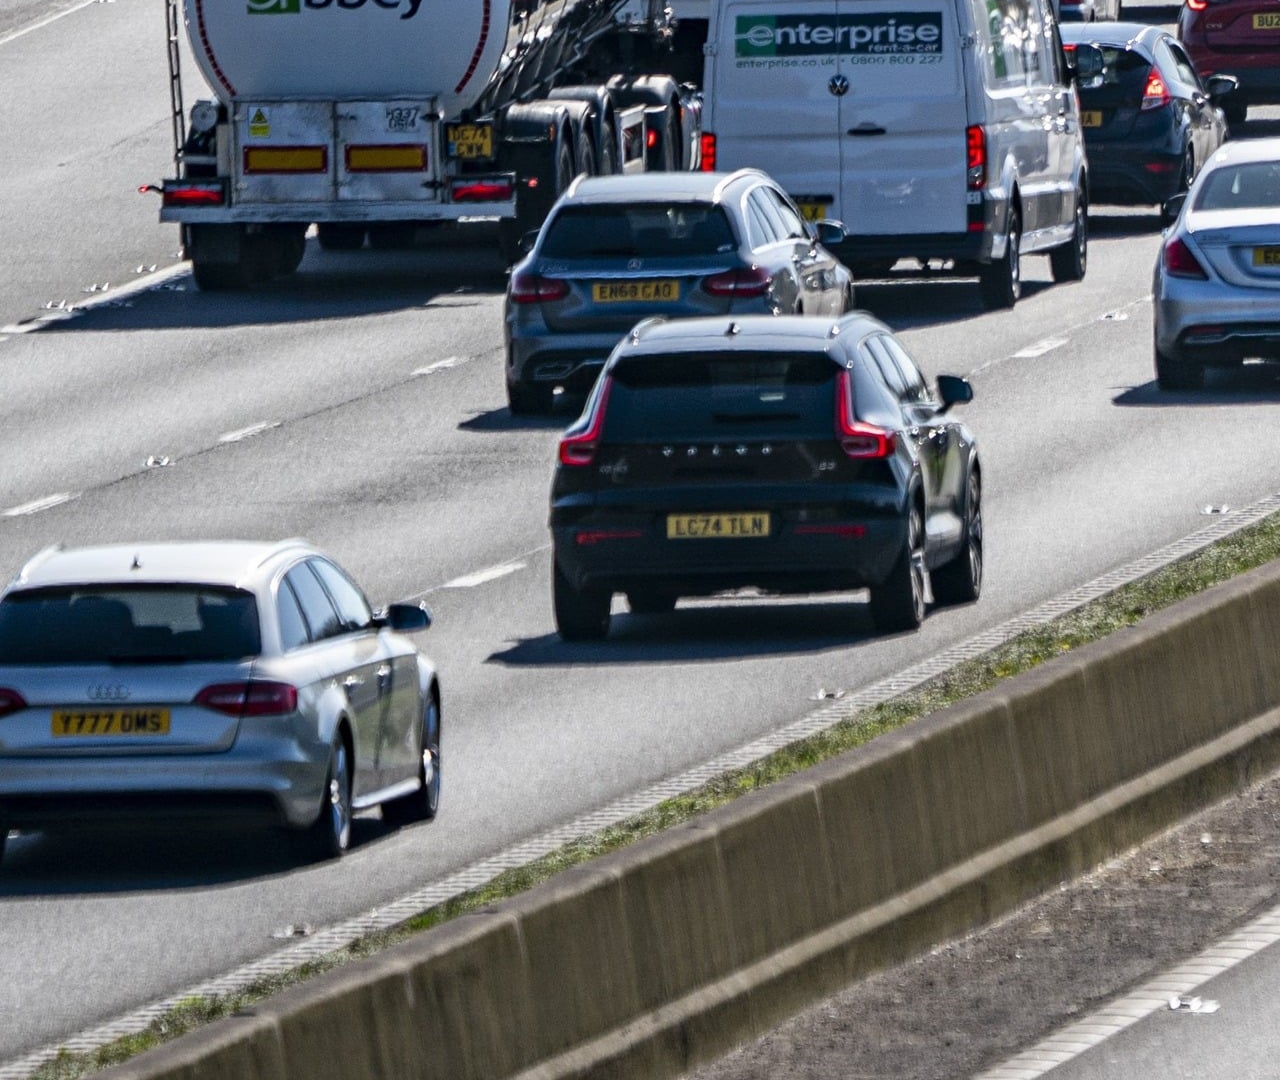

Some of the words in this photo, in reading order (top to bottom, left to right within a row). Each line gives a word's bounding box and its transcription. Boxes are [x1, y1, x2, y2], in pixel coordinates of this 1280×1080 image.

[749, 19, 939, 49] enterprise
[868, 43, 939, 53] rent-a-car
[736, 57, 835, 69] enterprise.co.uk
[851, 57, 885, 65] 0800
[675, 518, 722, 536] LC74
[730, 517, 762, 535] TLN
